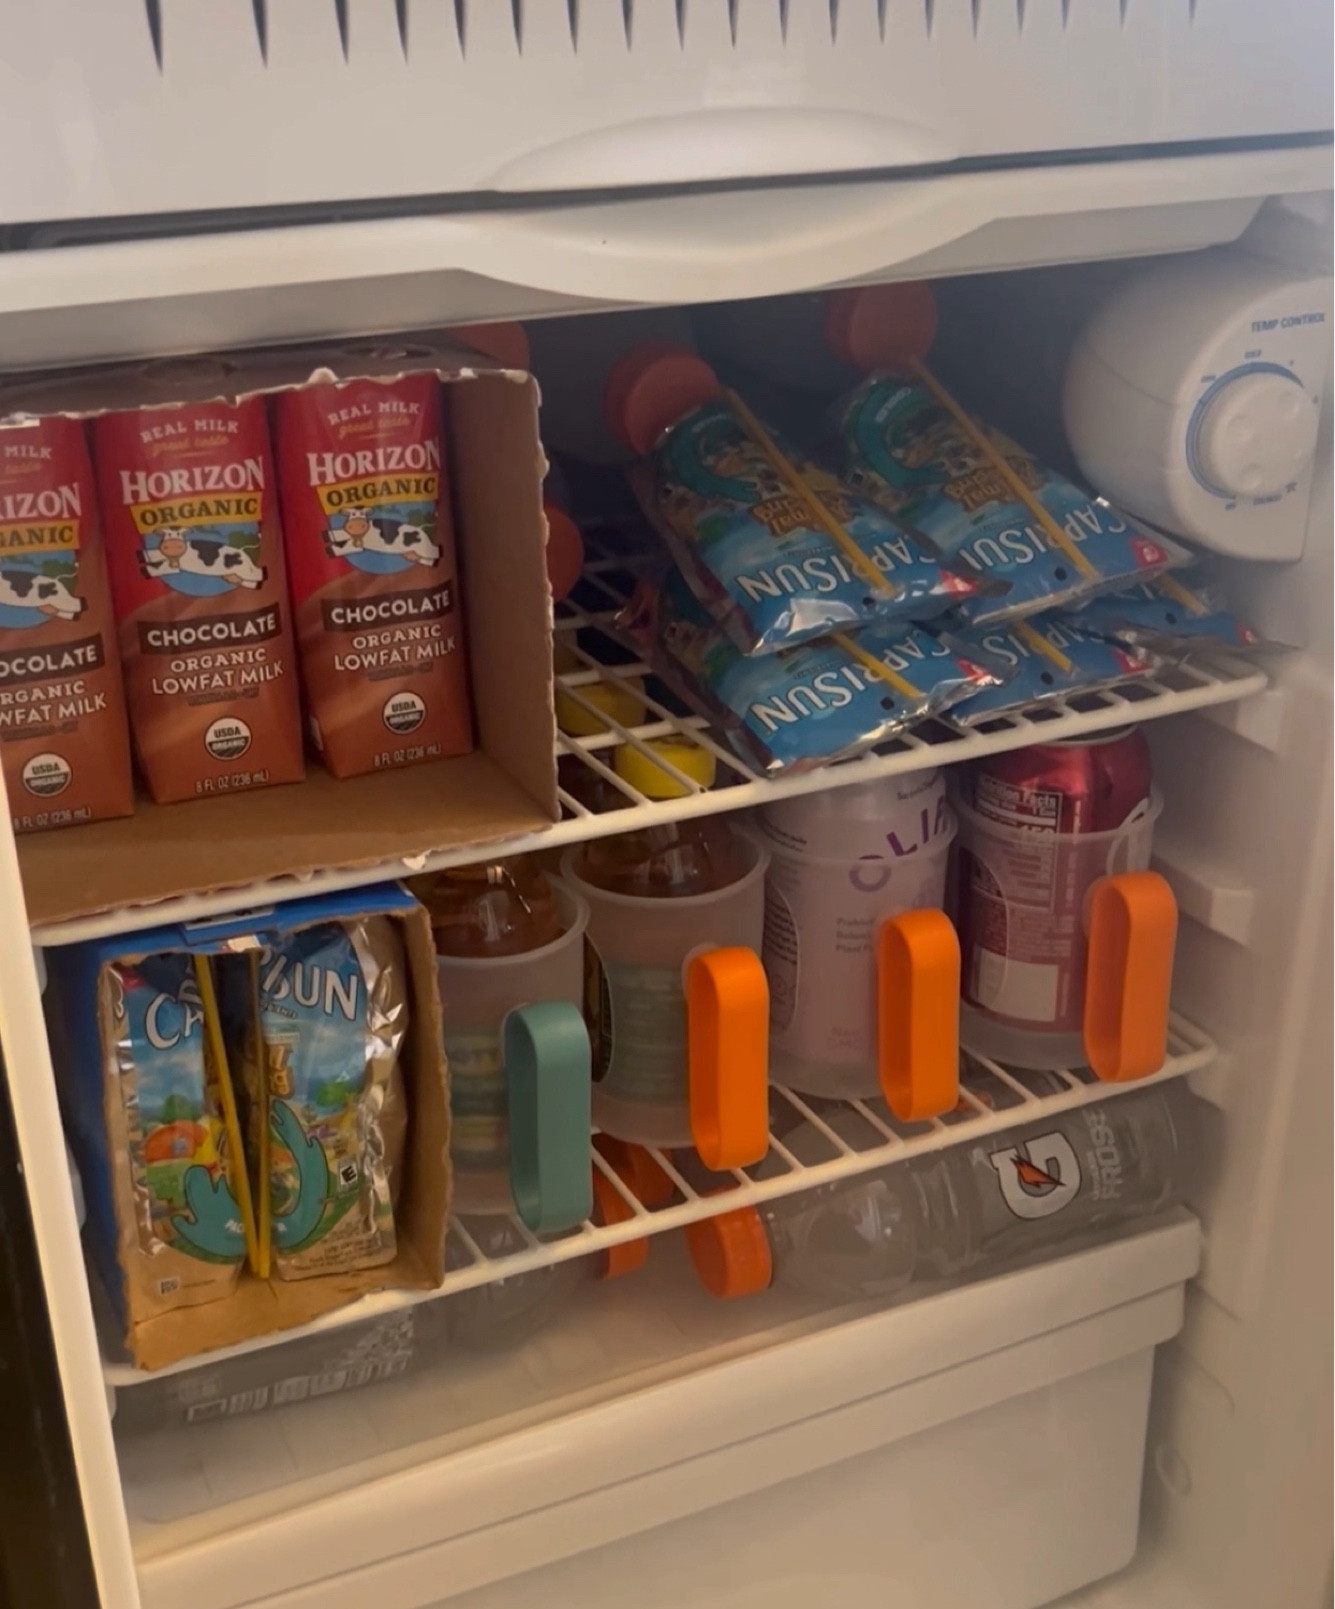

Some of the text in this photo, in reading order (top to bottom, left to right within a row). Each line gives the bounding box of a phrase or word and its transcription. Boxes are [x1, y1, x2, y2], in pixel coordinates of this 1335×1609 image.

[1250, 312, 1326, 333] TEMP CONTROL
[327, 401, 421, 426] REAL MILK
[139, 419, 239, 444] REAL MILK
[4, 444, 53, 460] MILK
[306, 438, 441, 487] HORIZON
[118, 455, 266, 505] HORIZON
[326, 477, 437, 507] ORGANIC
[0, 482, 82, 519] IZON
[139, 498, 258, 527] ORGANIC
[331, 590, 450, 624] CHOCOLATE
[146, 612, 277, 648] CHOCOLATE
[352, 624, 442, 649] ORGANIC
[170, 648, 267, 673] ORGANIC
[334, 636, 456, 671] LOWFAT MILK
[152, 661, 284, 695] LOWFAT MILK
[58, 692, 107, 720] MILK
[391, 700, 417, 713] USDA
[213, 726, 242, 739] USDA
[31, 762, 61, 776] USDA
[217, 775, 229, 789] OZ
